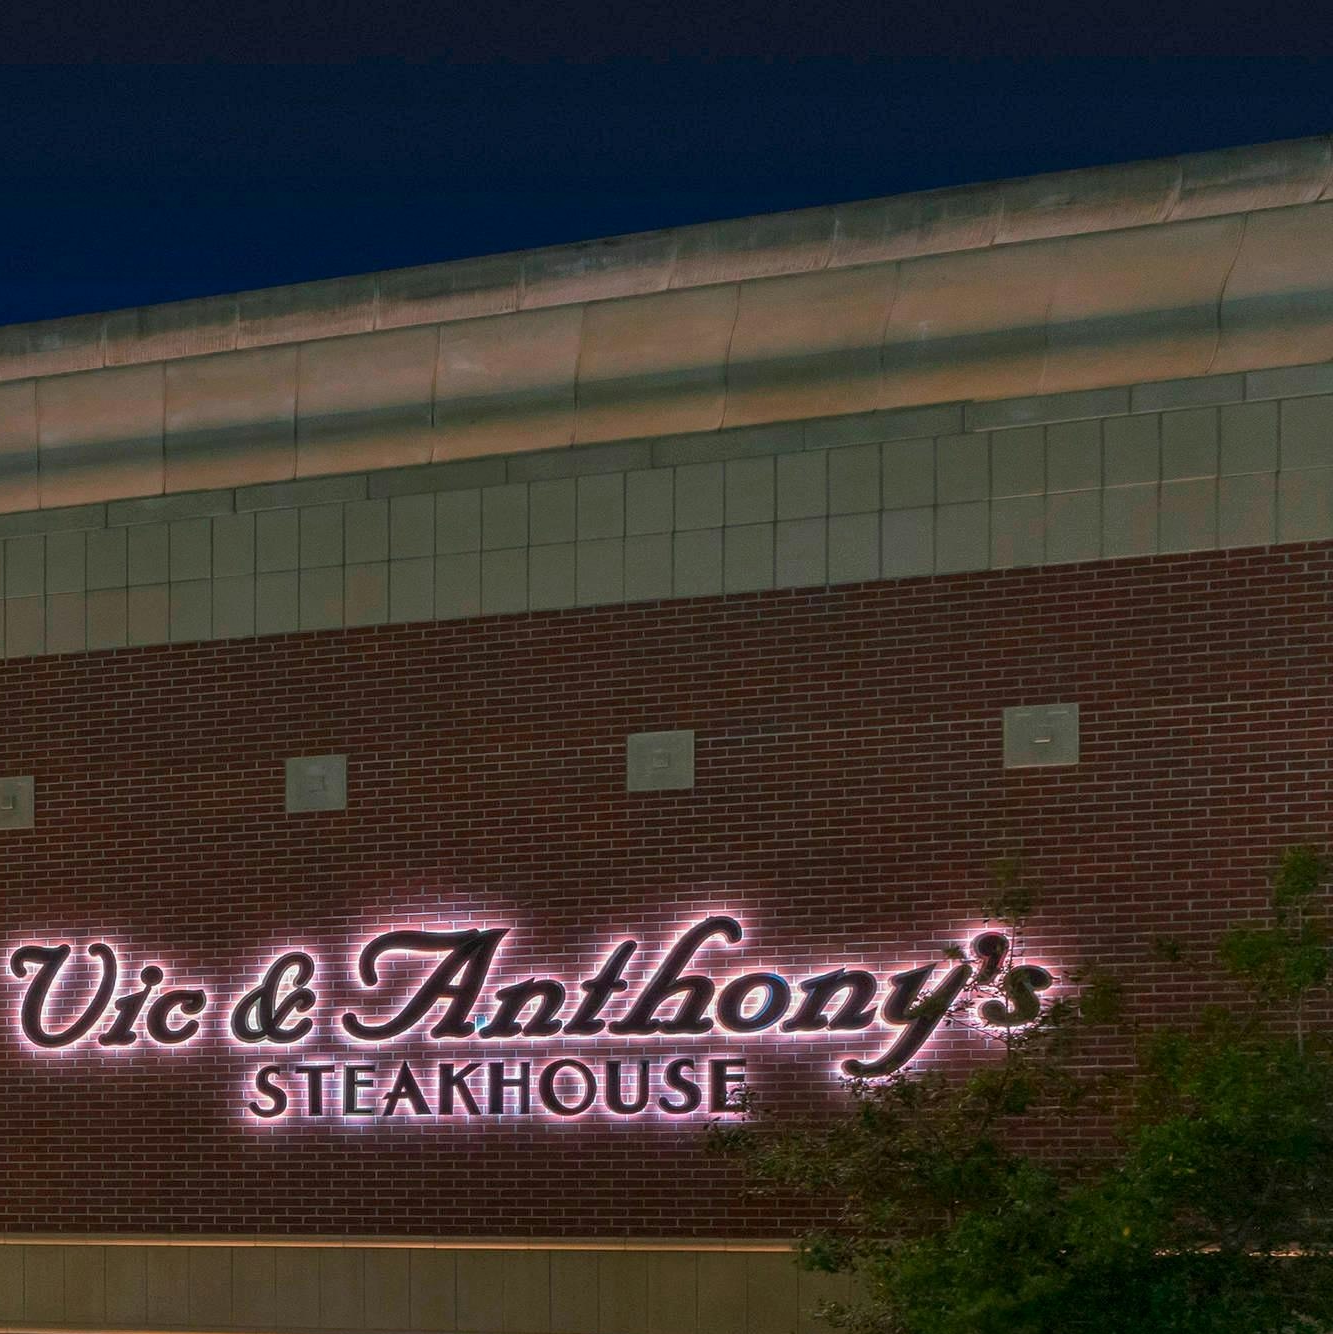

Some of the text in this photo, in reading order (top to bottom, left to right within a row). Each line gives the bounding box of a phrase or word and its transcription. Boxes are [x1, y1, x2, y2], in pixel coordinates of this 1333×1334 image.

[10, 915, 1054, 1079] Vic & Anthony's
[248, 1057, 748, 1118] STEAKHOUSE
